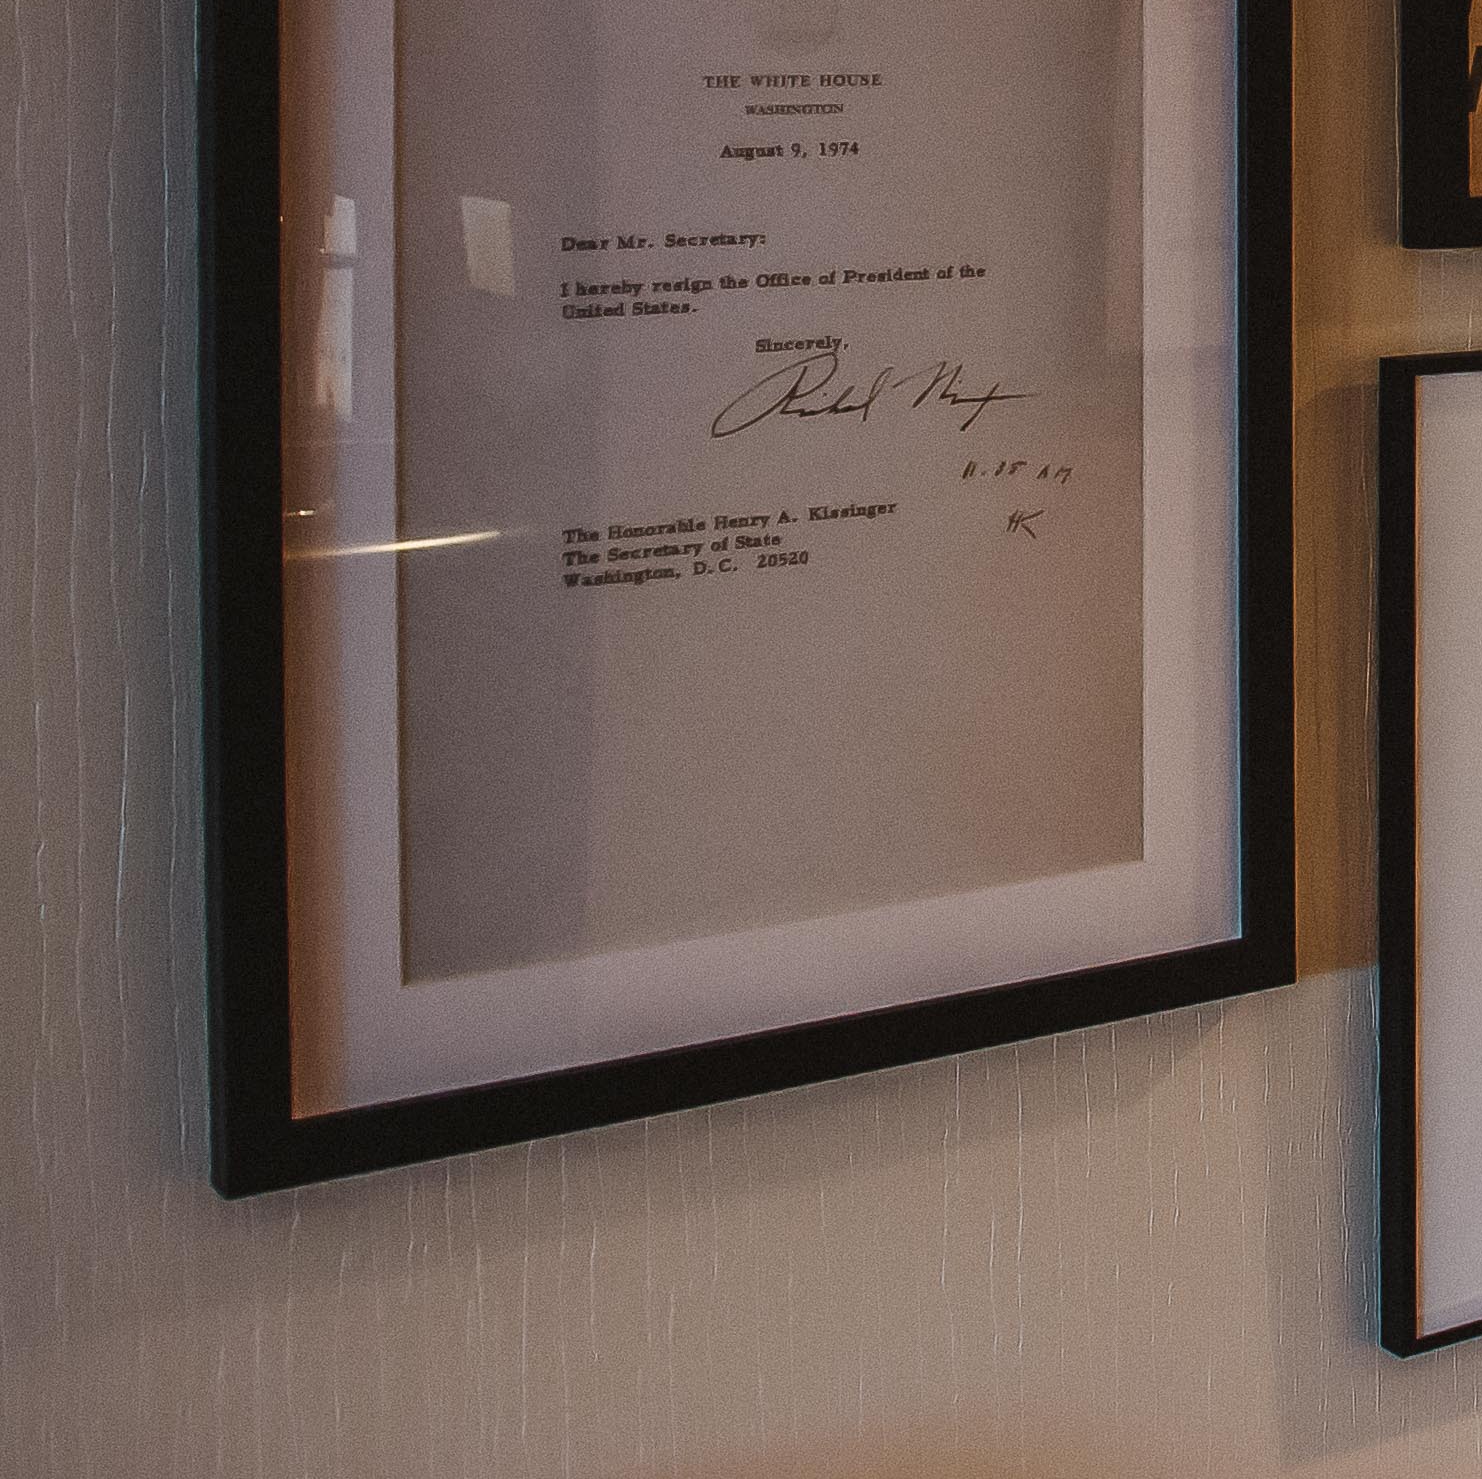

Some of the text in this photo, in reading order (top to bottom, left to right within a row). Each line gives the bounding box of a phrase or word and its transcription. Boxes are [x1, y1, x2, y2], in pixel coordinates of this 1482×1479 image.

[705, 74, 882, 88] THE WHITE HOUSE
[720, 142, 859, 161] August 9, 1974
[562, 234, 765, 251] Dear Mr. Secretary:
[561, 265, 986, 297] I hereby resign the Office of President of the
[562, 302, 700, 318] United States.
[755, 337, 849, 353] Sincerely,
